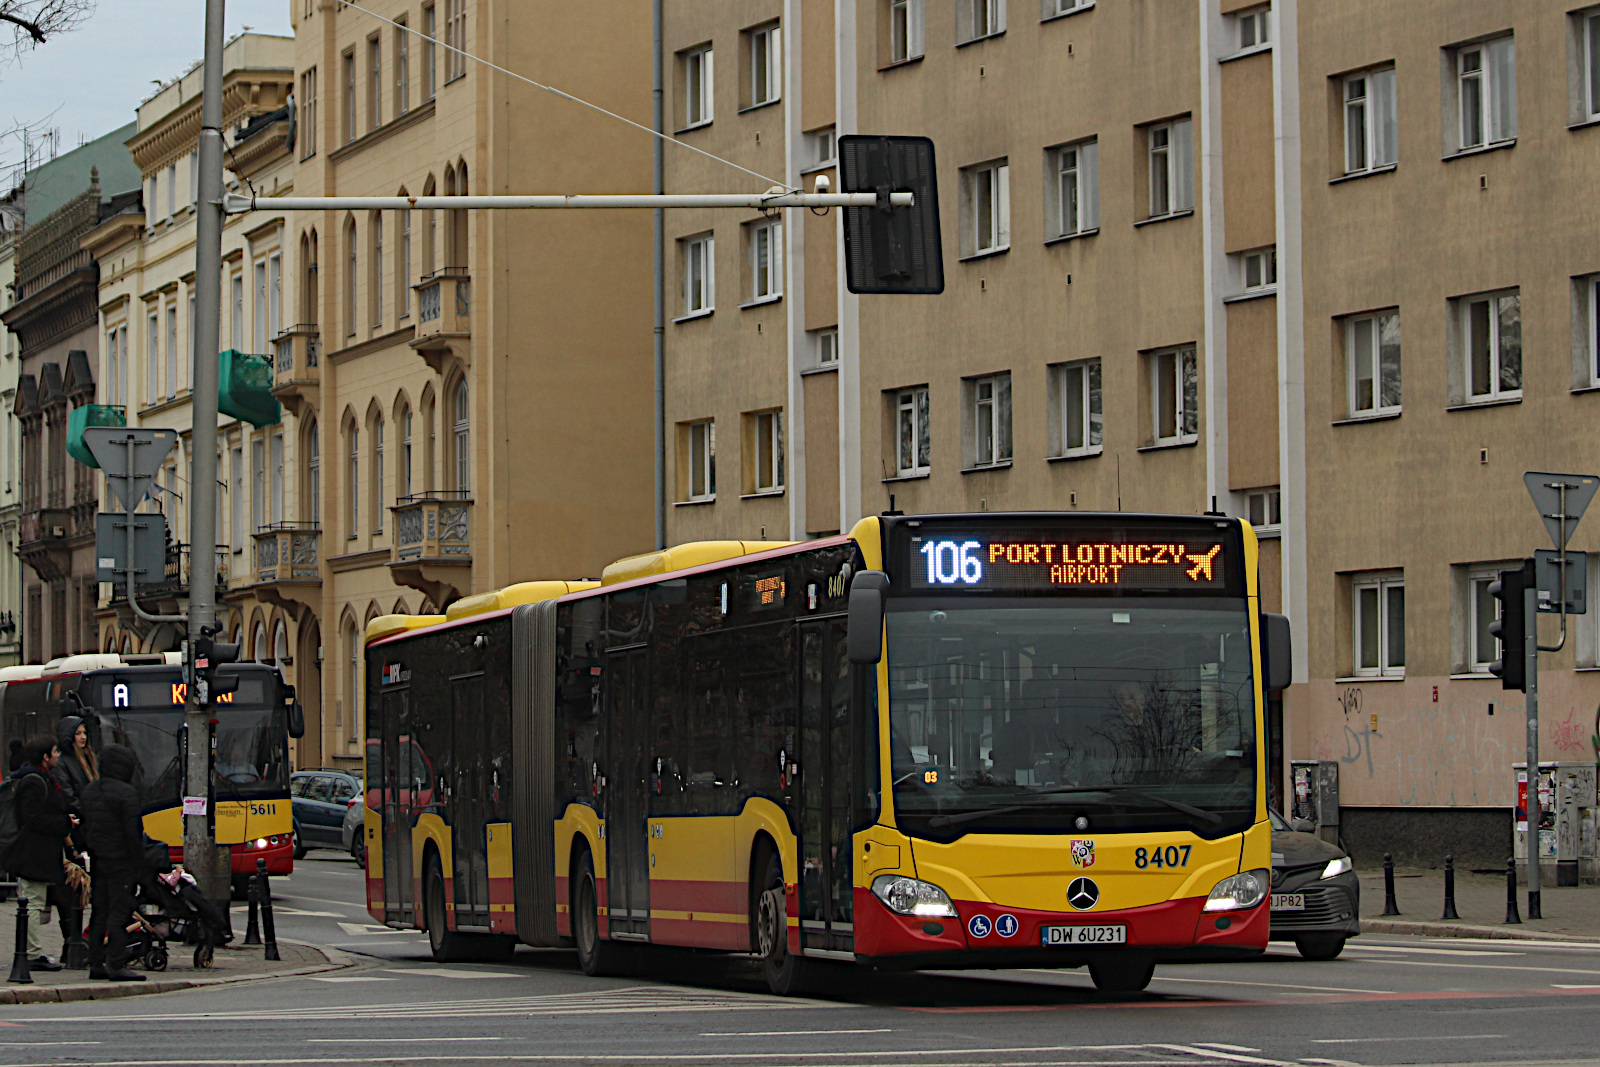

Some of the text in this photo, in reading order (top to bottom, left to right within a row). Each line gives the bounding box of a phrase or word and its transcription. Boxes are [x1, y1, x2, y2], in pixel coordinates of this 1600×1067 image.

[920, 540, 982, 584] 106
[989, 543, 1185, 564] PORT LOTNICZY
[1050, 564, 1123, 584] AIRPORT
[828, 575, 845, 598] 8407
[113, 683, 129, 707] A
[924, 770, 938, 784] 03
[250, 803, 276, 816] 5611
[1134, 844, 1193, 870] 8407
[1051, 926, 1121, 943] DW 6U231
